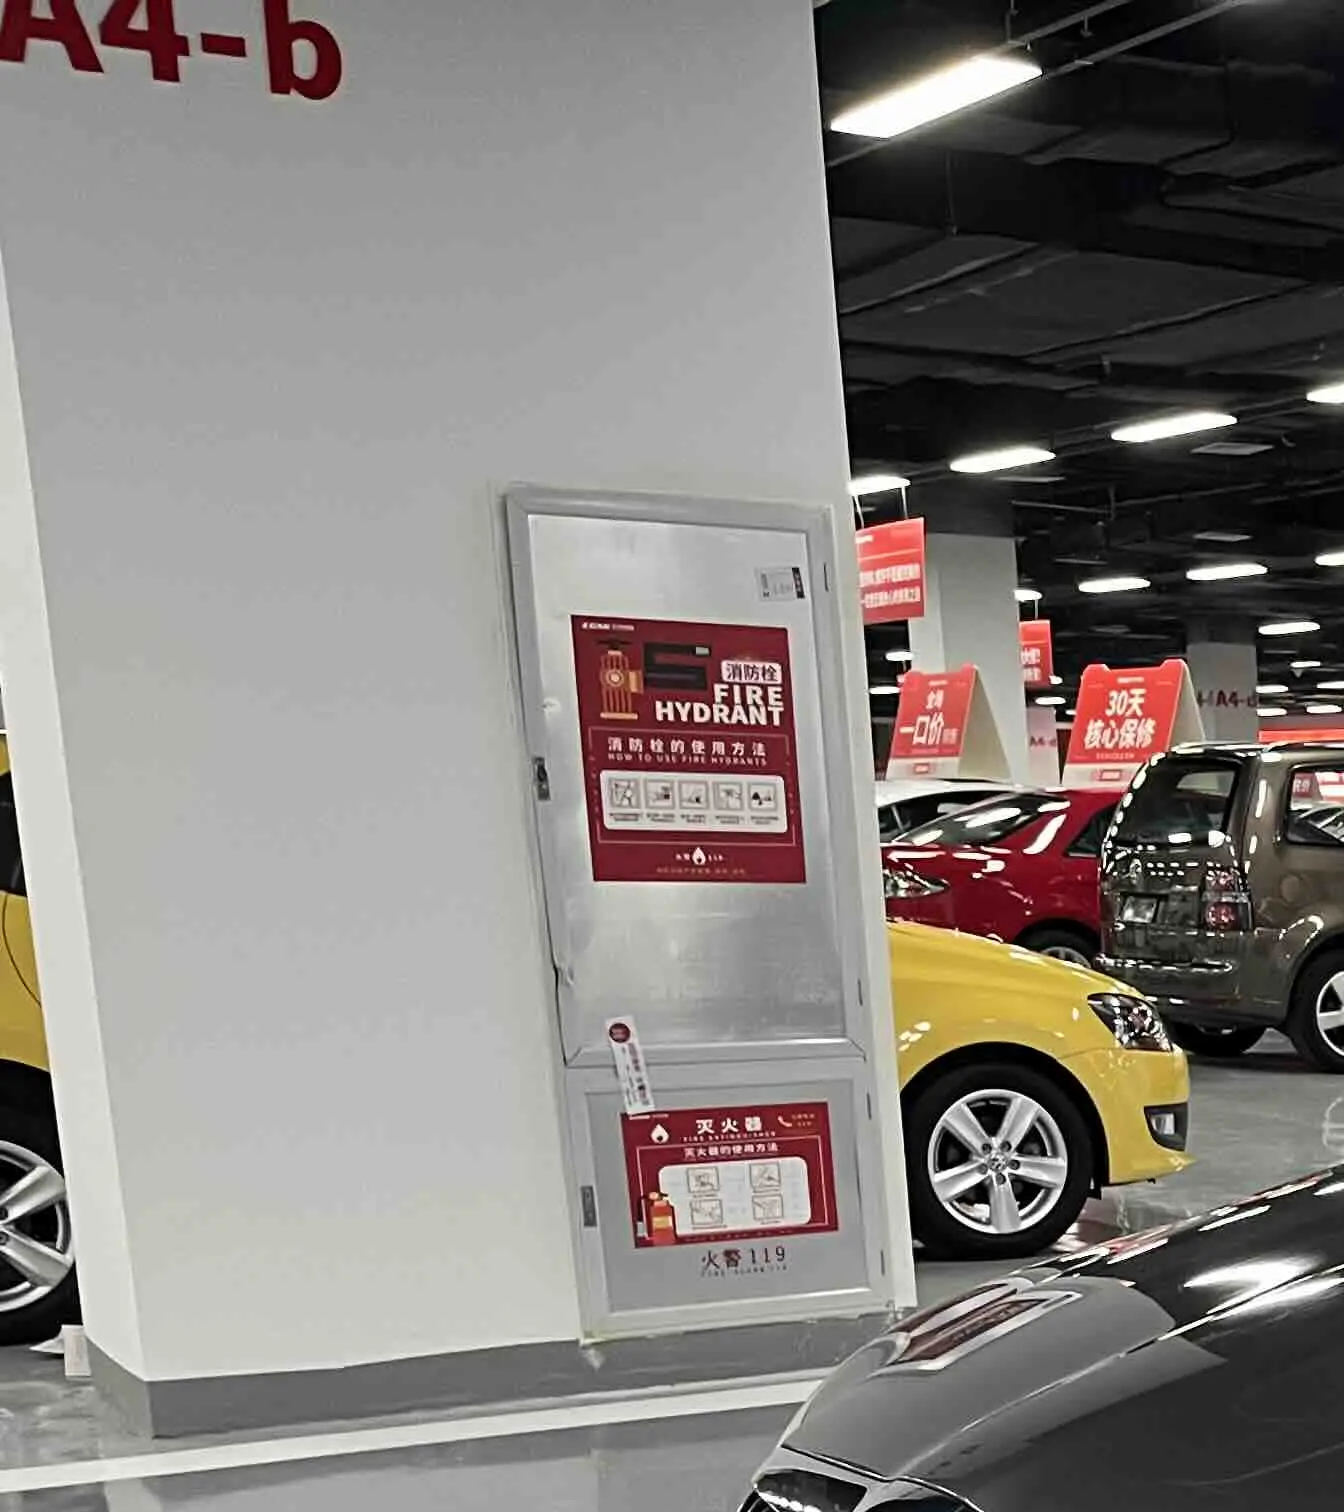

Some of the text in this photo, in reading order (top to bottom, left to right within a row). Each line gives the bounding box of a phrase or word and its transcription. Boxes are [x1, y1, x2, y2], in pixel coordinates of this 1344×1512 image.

[0, 0, 342, 100] A4-b
[726, 663, 779, 682] 消防栓
[713, 683, 783, 706] FIRE
[1105, 687, 1147, 717] 30天
[655, 701, 784, 726] HYDRANT
[899, 712, 945, 745] 一口价
[1084, 718, 1157, 750] 核心保修
[607, 737, 766, 757] 消防栓的使用方法
[695, 1116, 762, 1135] 灭火器
[701, 1245, 786, 1270] 火警 119
